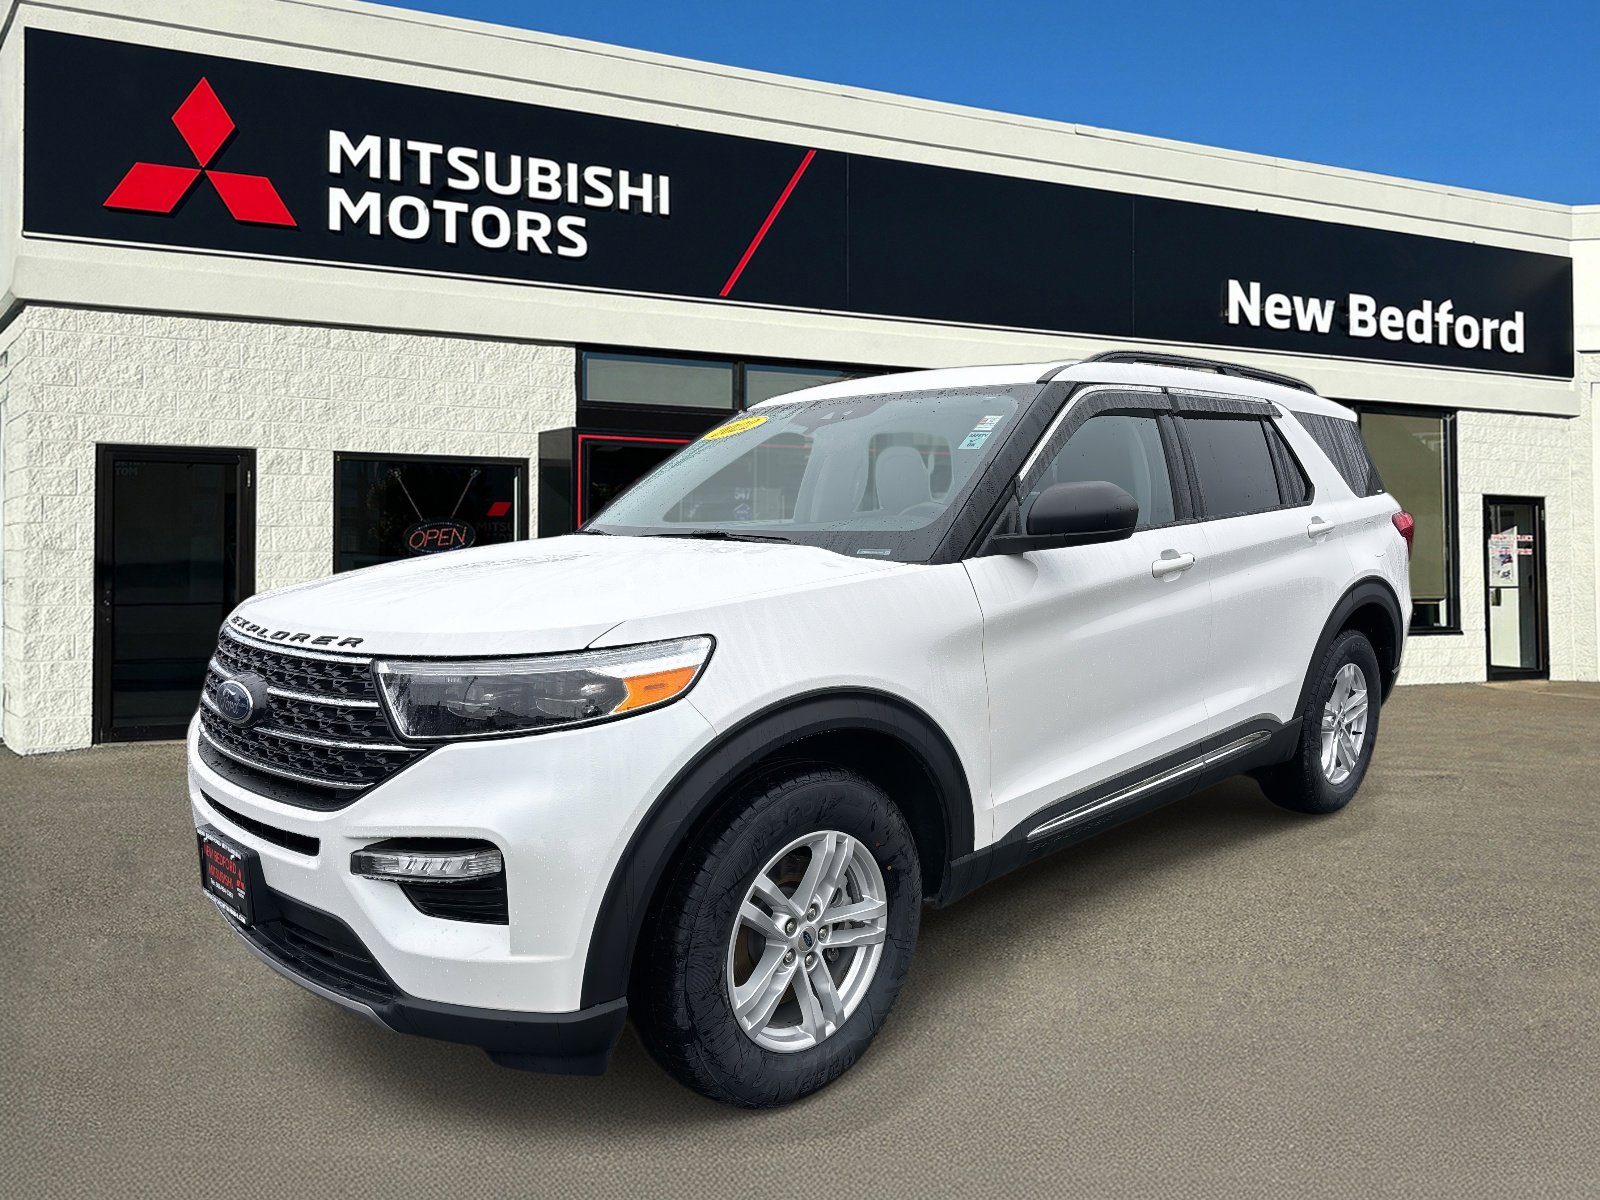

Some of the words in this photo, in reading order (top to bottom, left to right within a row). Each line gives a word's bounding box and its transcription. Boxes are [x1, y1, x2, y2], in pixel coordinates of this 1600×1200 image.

[328, 129, 670, 216] MITSUBISHI
[328, 186, 589, 258] MOTORS
[1227, 279, 1336, 334] New
[1348, 292, 1525, 354] Bedford
[408, 526, 468, 550] OPEN
[230, 615, 365, 648] EXPLORER
[219, 688, 243, 715] Ford
[214, 848, 237, 874] BEDFORD
